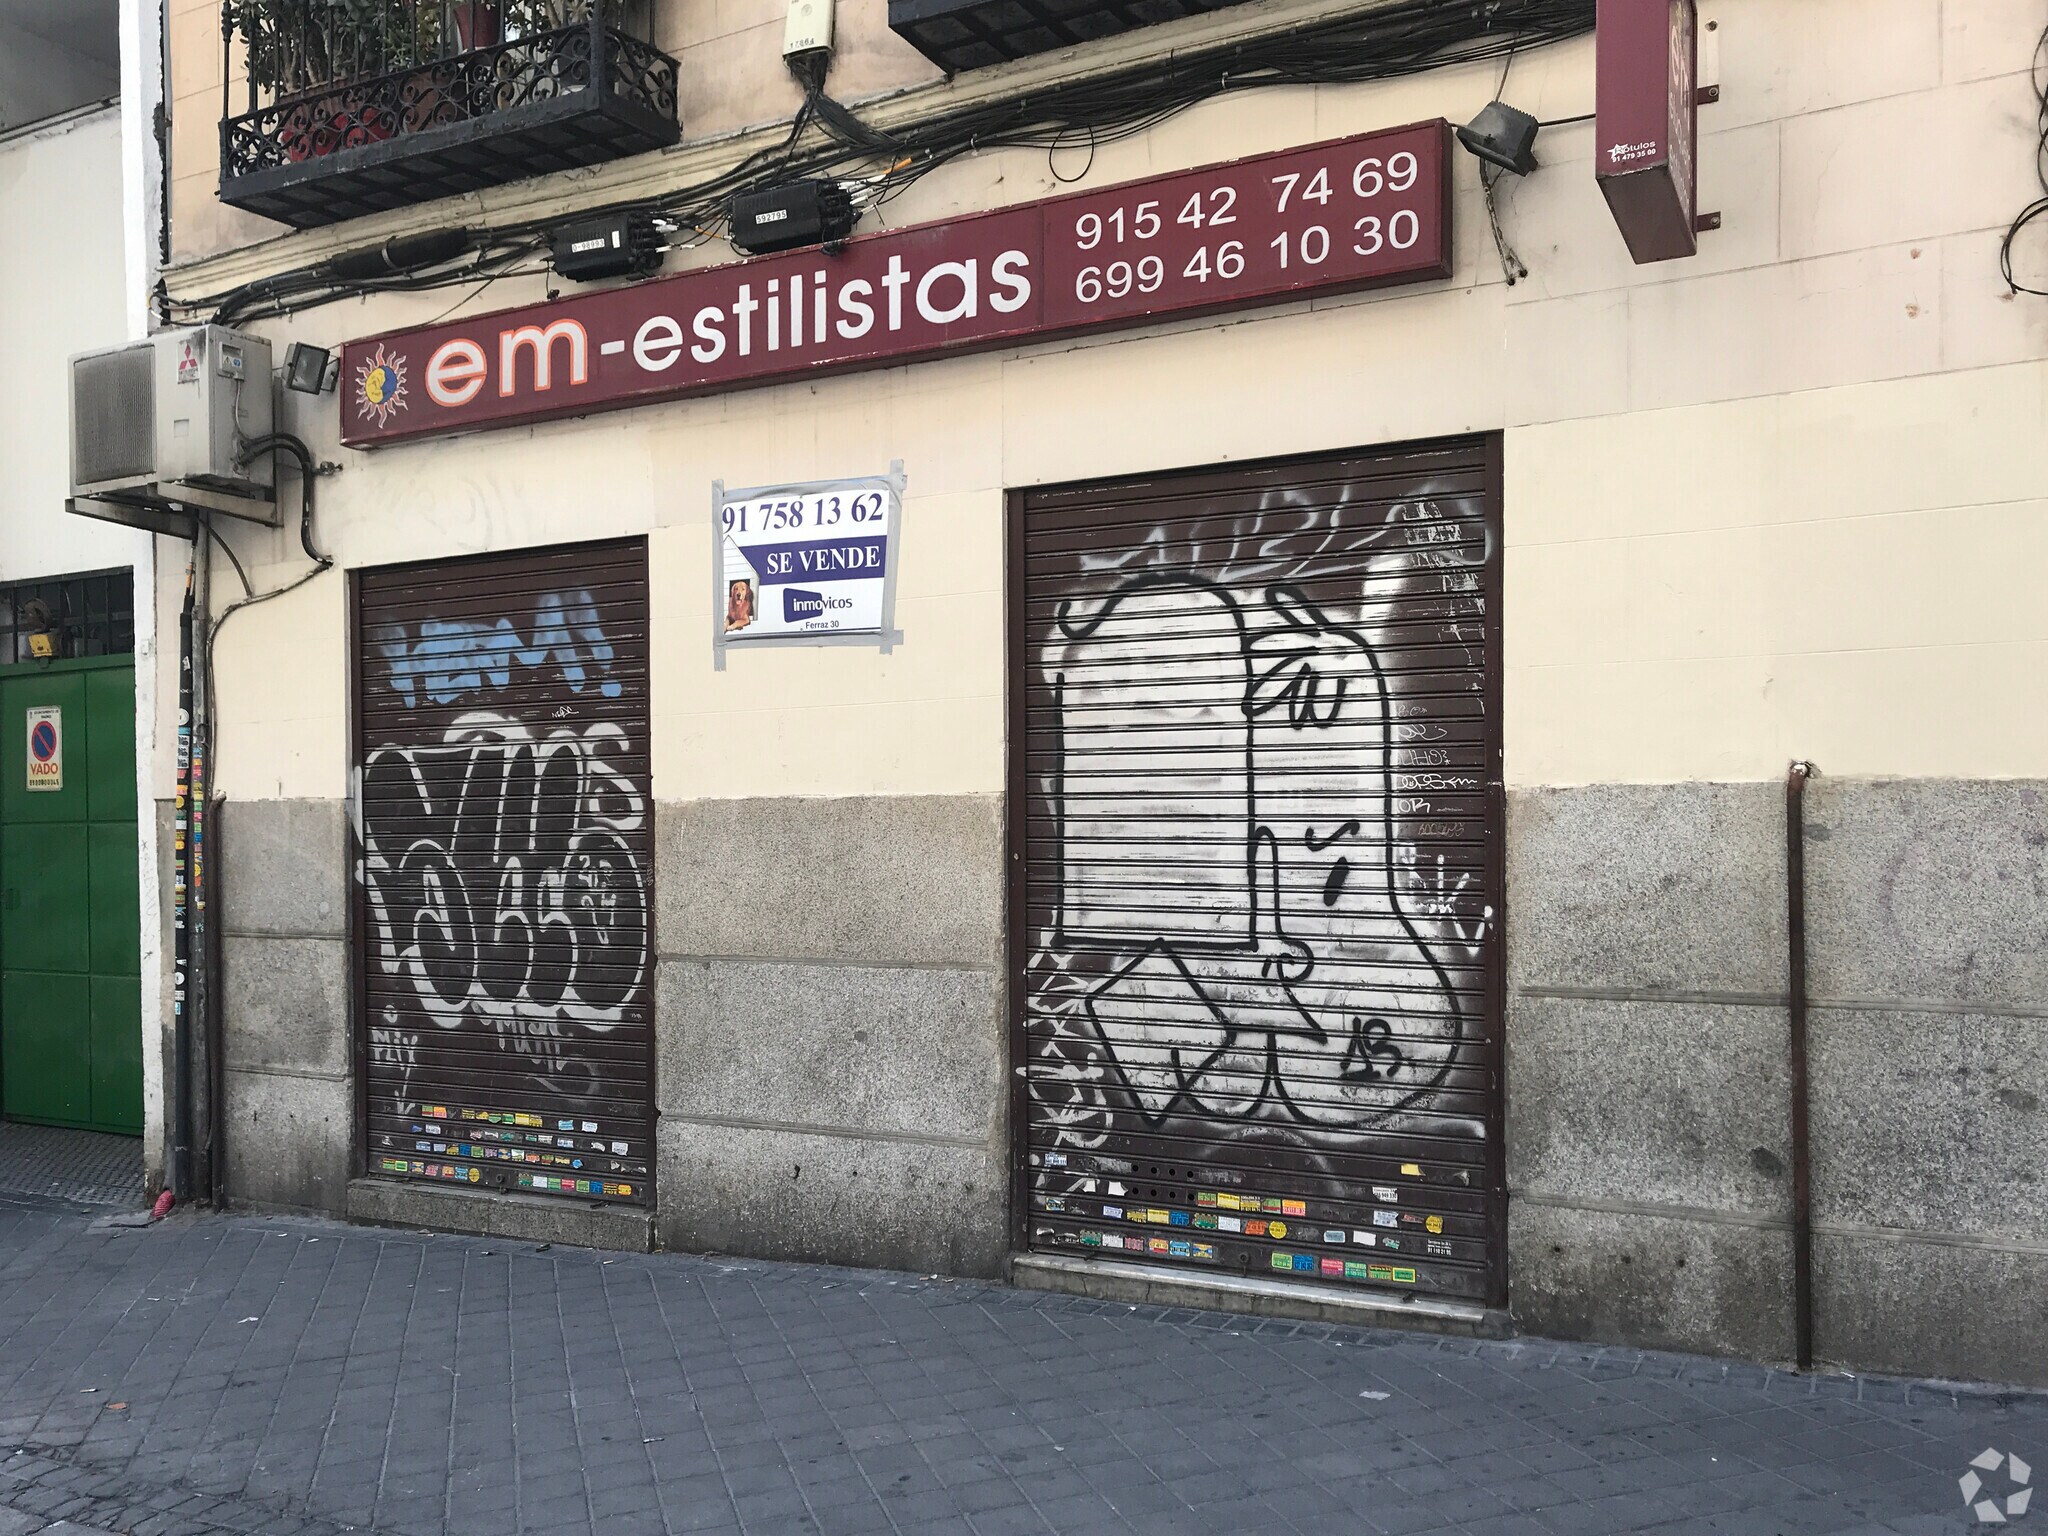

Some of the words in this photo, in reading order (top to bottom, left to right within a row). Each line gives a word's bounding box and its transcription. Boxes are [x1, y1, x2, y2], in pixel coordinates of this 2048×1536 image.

[1622, 152, 1635, 160] 479
[1647, 148, 1656, 156] 00
[1075, 200, 1162, 250] 915
[1176, 186, 1238, 229] 42
[1271, 167, 1334, 214] 74
[1352, 151, 1418, 198] 69
[1075, 256, 1165, 303] 699
[1182, 240, 1246, 283] 46
[1270, 225, 1331, 269] 10
[1353, 209, 1420, 256] 30
[723, 506, 749, 534] 91
[758, 501, 804, 531] 758
[813, 496, 842, 526] 13
[851, 493, 883, 522] 62
[767, 551, 793, 575] SE
[799, 546, 881, 571] VENDE
[793, 596, 853, 612] inmovicos
[805, 621, 829, 629] Ferraz
[830, 620, 840, 628] 30
[30, 763, 58, 775] VADO
